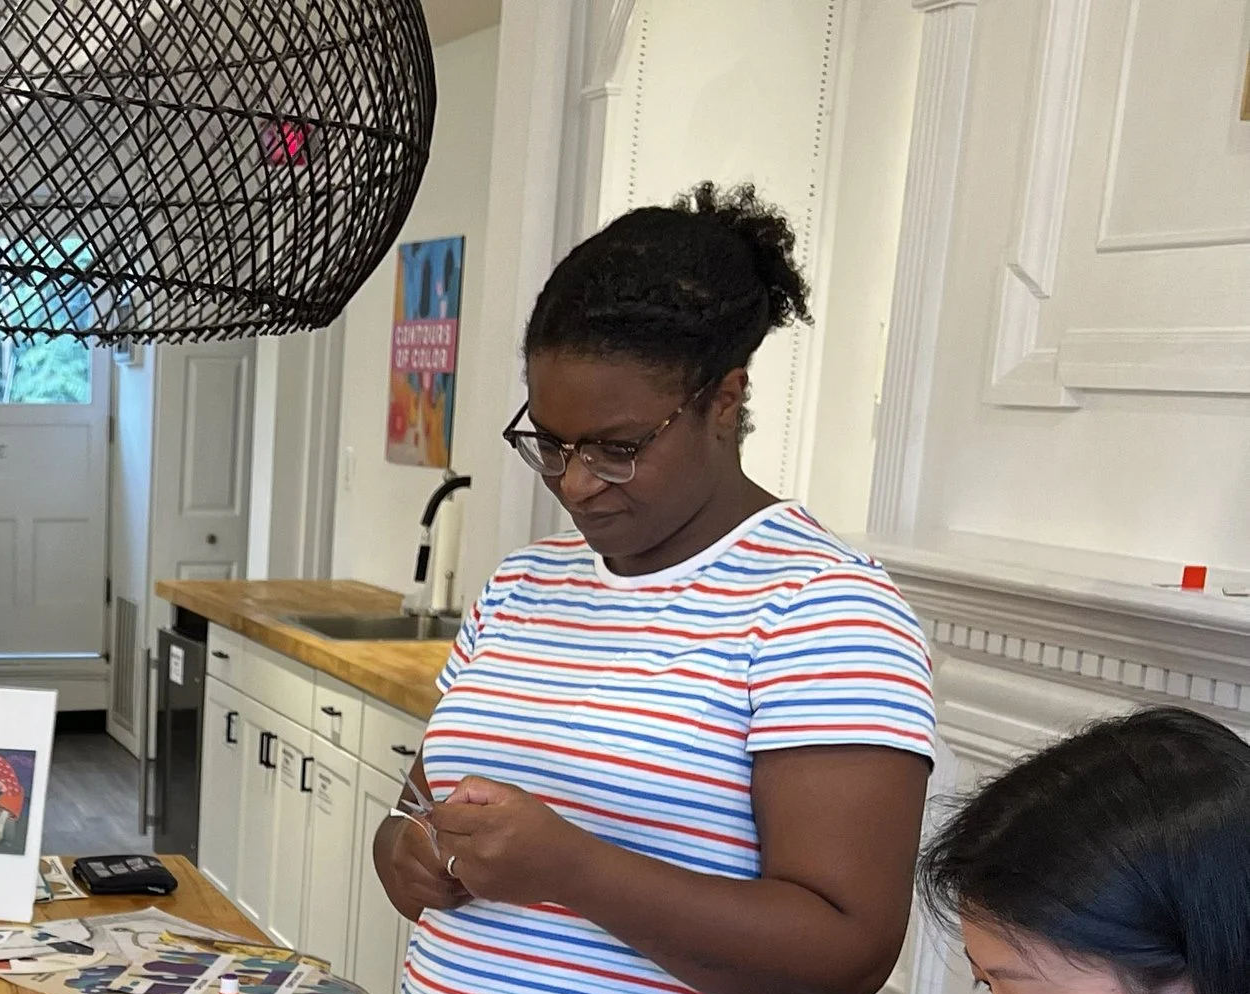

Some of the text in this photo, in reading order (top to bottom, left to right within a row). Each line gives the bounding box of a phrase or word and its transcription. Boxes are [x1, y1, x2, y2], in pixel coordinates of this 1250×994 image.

[394, 324, 451, 345] CONTOURS
[395, 349, 448, 369] OF COLOR
